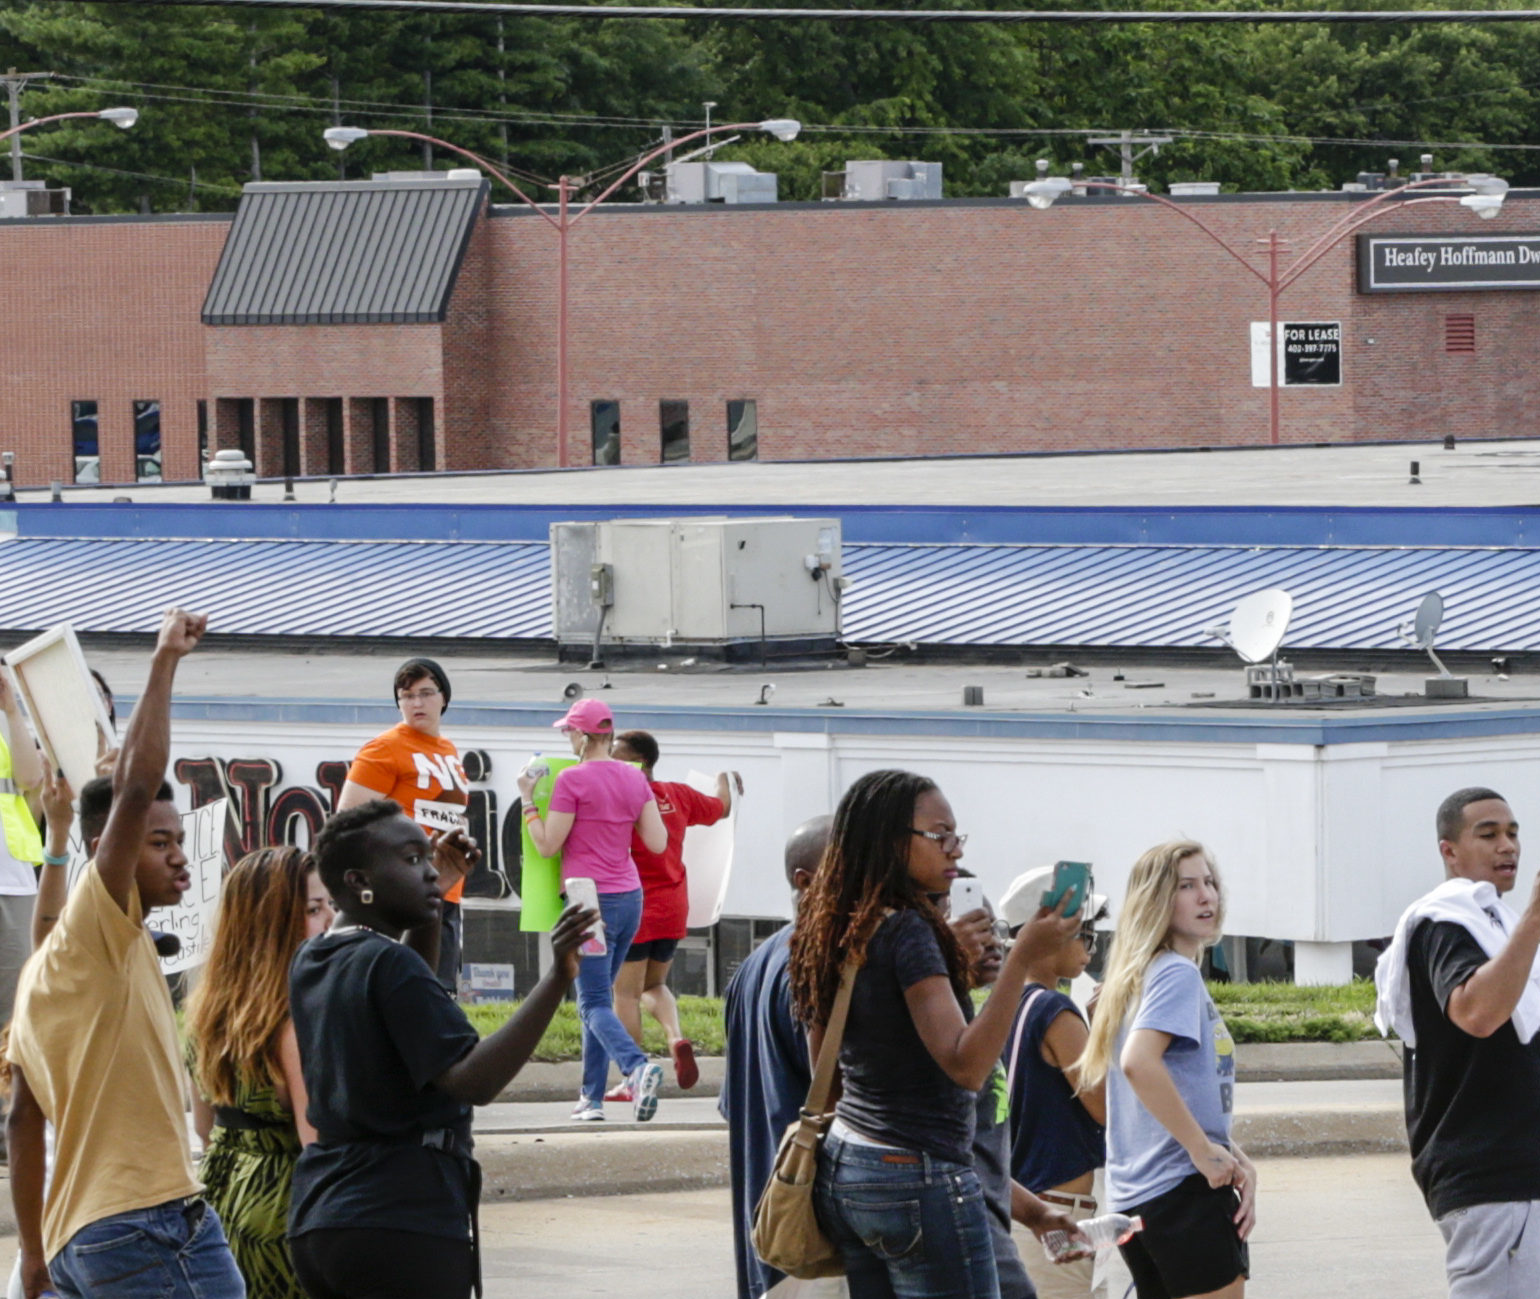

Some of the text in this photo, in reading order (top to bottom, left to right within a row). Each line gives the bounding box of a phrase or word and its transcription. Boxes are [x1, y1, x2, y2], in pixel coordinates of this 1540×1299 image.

[1384, 247, 1437, 272] Heafey
[1440, 246, 1516, 266] Hoffmann
[1285, 328, 1339, 341] FOR LEASE
[1287, 343, 1337, 353] 402-397-7775
[145, 910, 200, 940] erling
